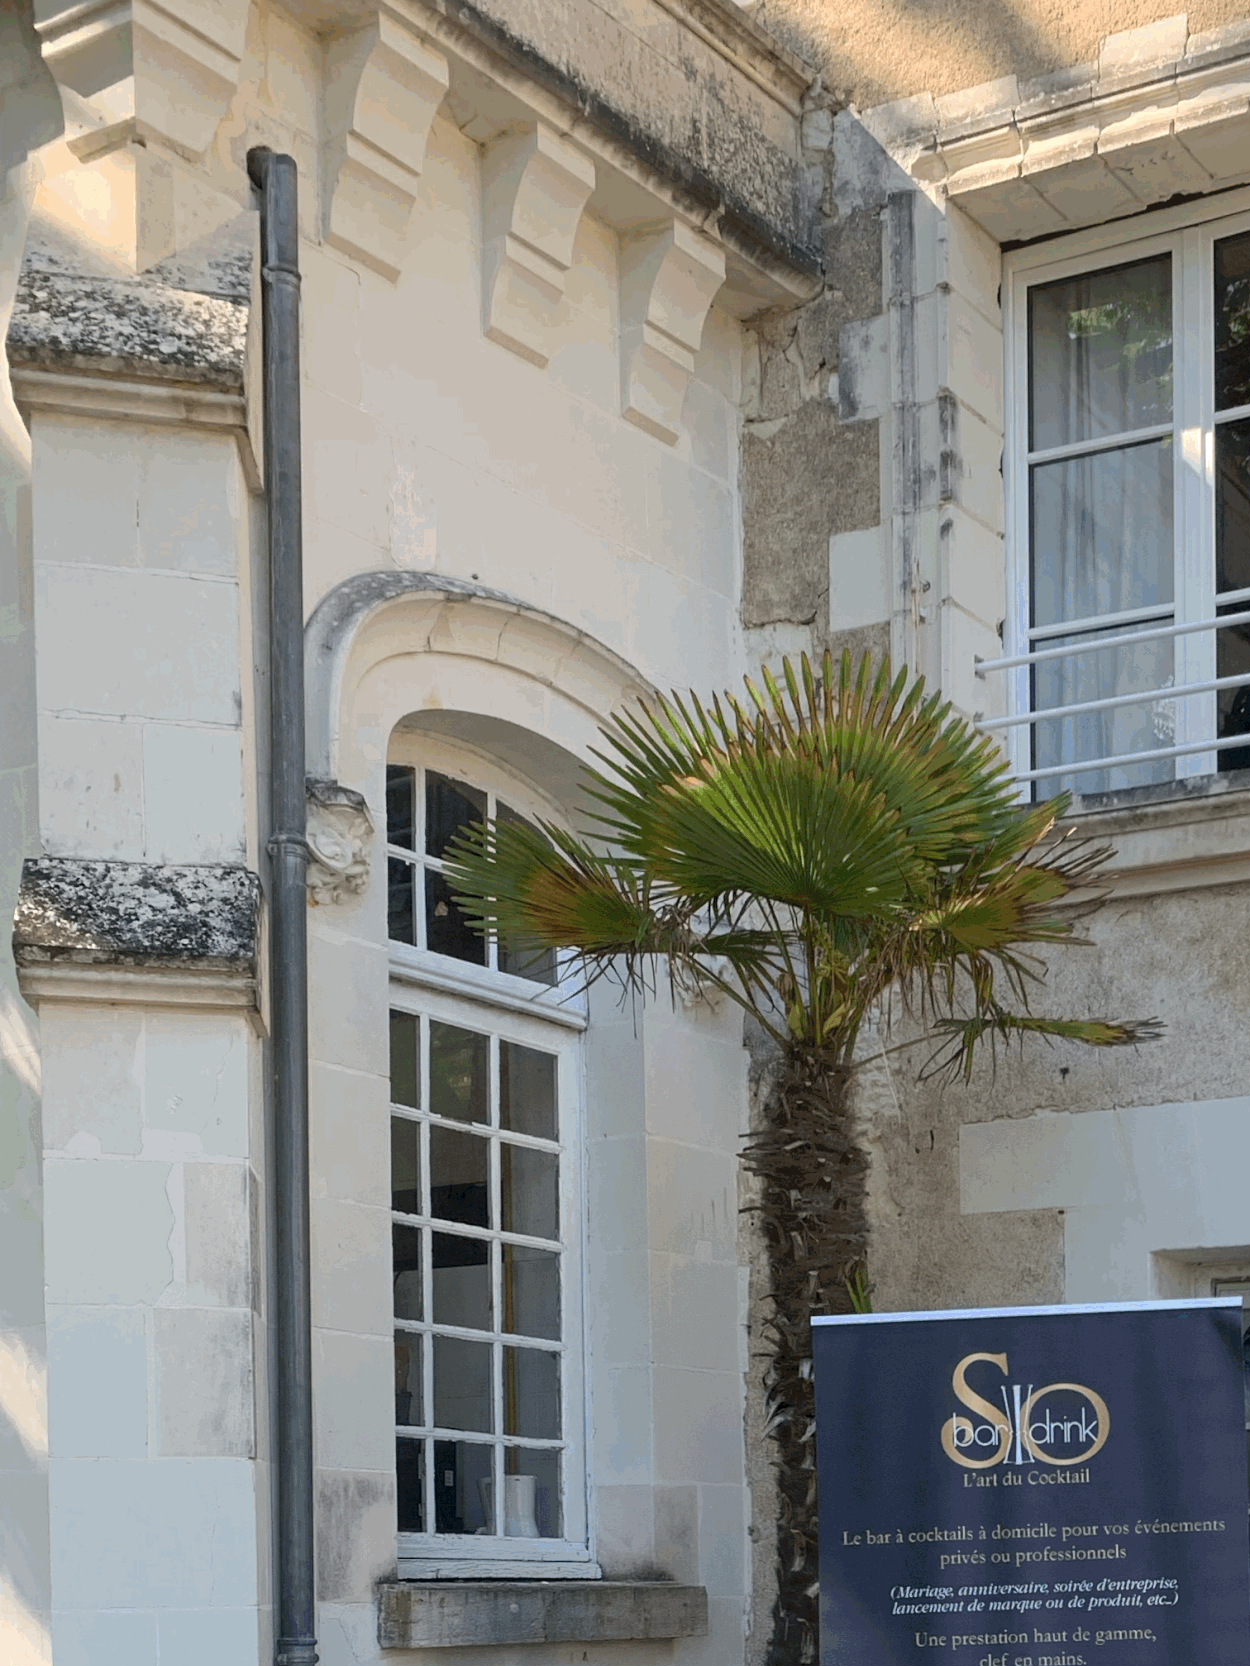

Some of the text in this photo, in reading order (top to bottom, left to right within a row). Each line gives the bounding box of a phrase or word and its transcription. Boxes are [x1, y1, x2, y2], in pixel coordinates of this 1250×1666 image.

[953, 1407, 1098, 1447] bar drink
[963, 1468, 1091, 1488] L'art du Cocktail
[843, 1519, 1226, 1546] Le bar à cocktails à domicile pour vos événements
[940, 1544, 1127, 1569] privés ou professionnels
[890, 1577, 1179, 1600] (Mariage, anniversaire, soirée d'entreprise,
[892, 1600, 964, 1615] lancement
[967, 1598, 985, 1612] de
[989, 1599, 1042, 1614] marque
[1045, 1599, 1064, 1610] ou
[1067, 1595, 1085, 1609] de
[1088, 1593, 1143, 1611] produit,
[915, 1626, 1157, 1650] Une prestation haut de gamme,
